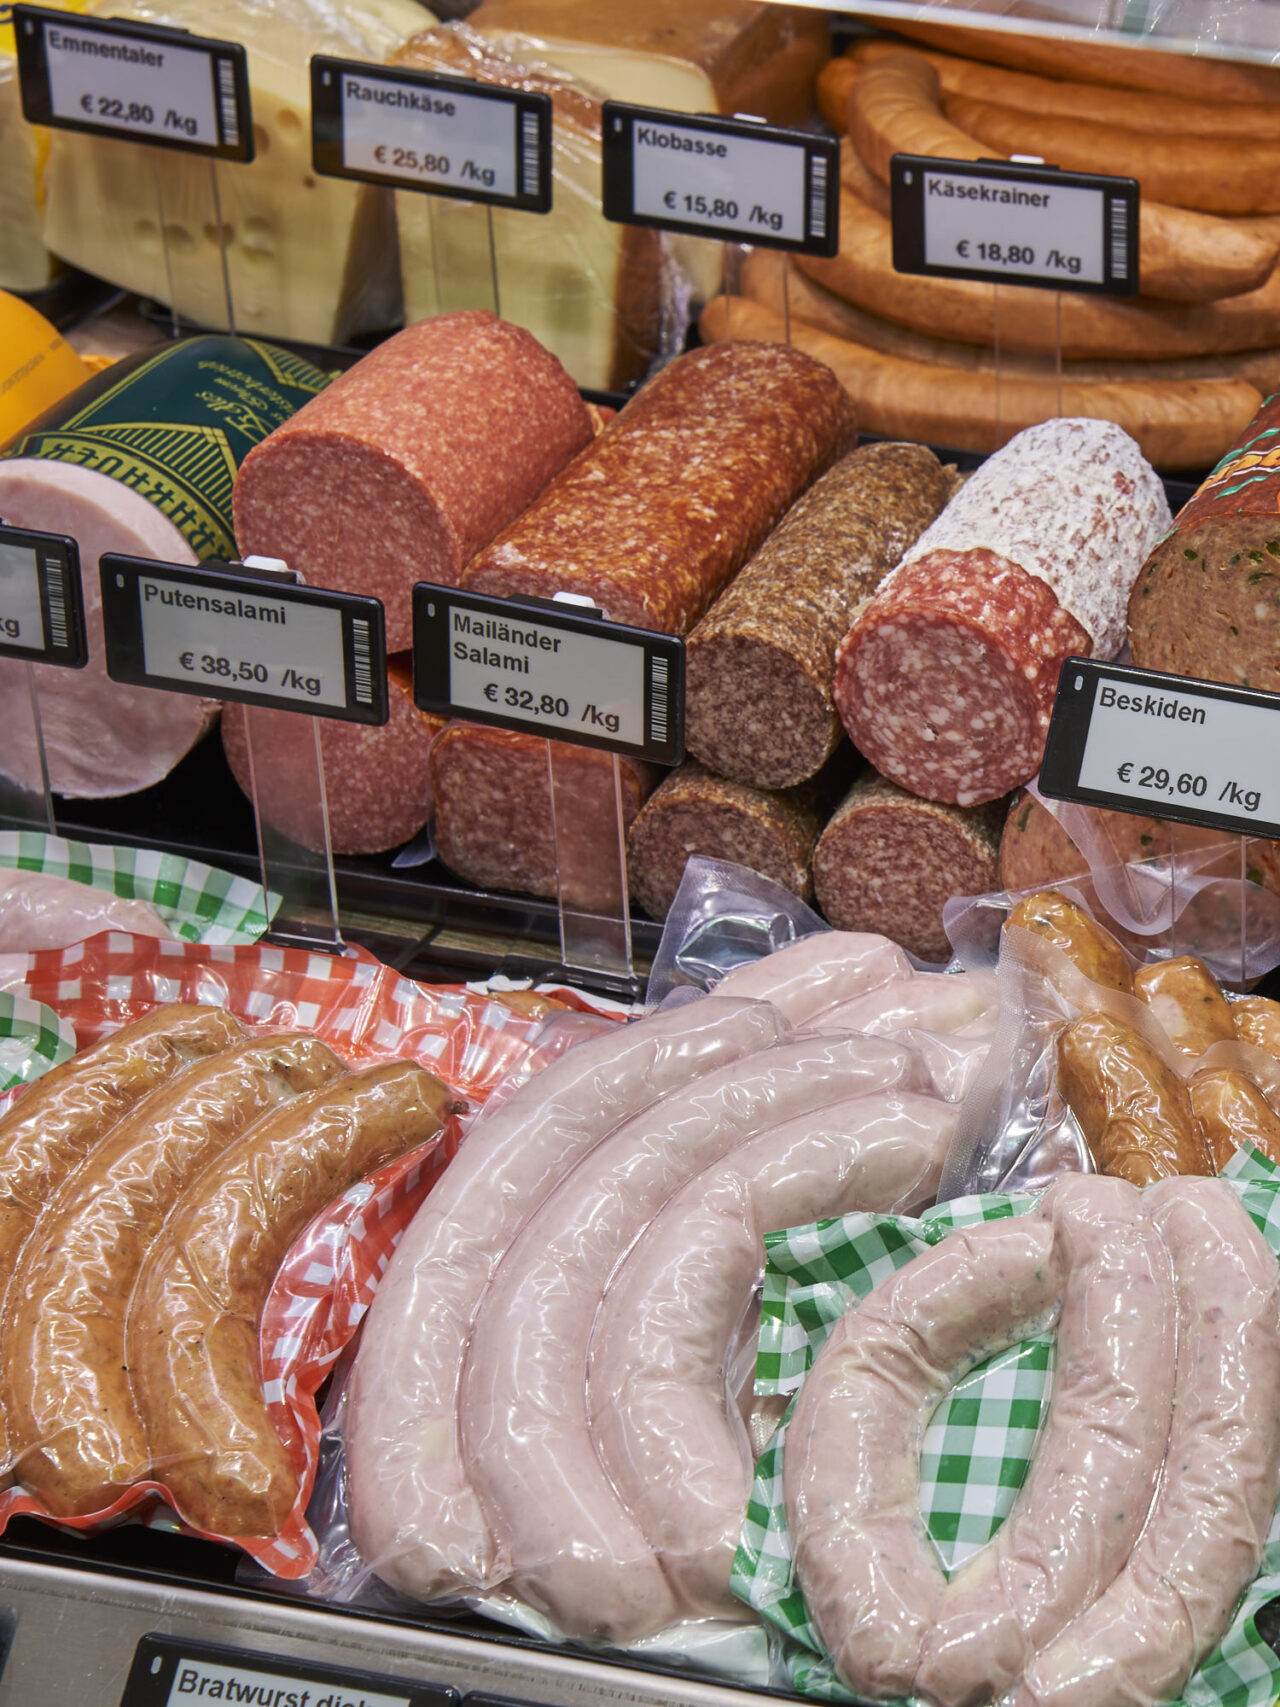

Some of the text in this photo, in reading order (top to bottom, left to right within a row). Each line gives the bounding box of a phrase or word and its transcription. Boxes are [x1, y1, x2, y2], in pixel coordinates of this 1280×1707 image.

[48, 30, 164, 68] Emmentaler
[80, 93, 198, 136] € 22,80 /kg
[346, 81, 456, 117] Rauchkäse
[637, 127, 728, 158] Klobasse
[374, 146, 496, 187] € 25,80 /kg
[663, 190, 784, 231] € 15,80 /kg
[928, 178, 1050, 208] Käsekrainer
[955, 240, 1082, 275] € 18,80 /kg
[144, 583, 287, 626] Putensalami
[0, 617, 20, 639] g
[453, 612, 562, 654] Mailänder
[179, 651, 321, 697] € 38,50 /kg
[453, 640, 530, 675] Salami
[483, 682, 620, 734] € 32,80 /kg
[1099, 687, 1206, 725] Beskiden
[1116, 761, 1262, 813] € 29,60 /kg
[177, 1668, 310, 1707] Bratwurst
